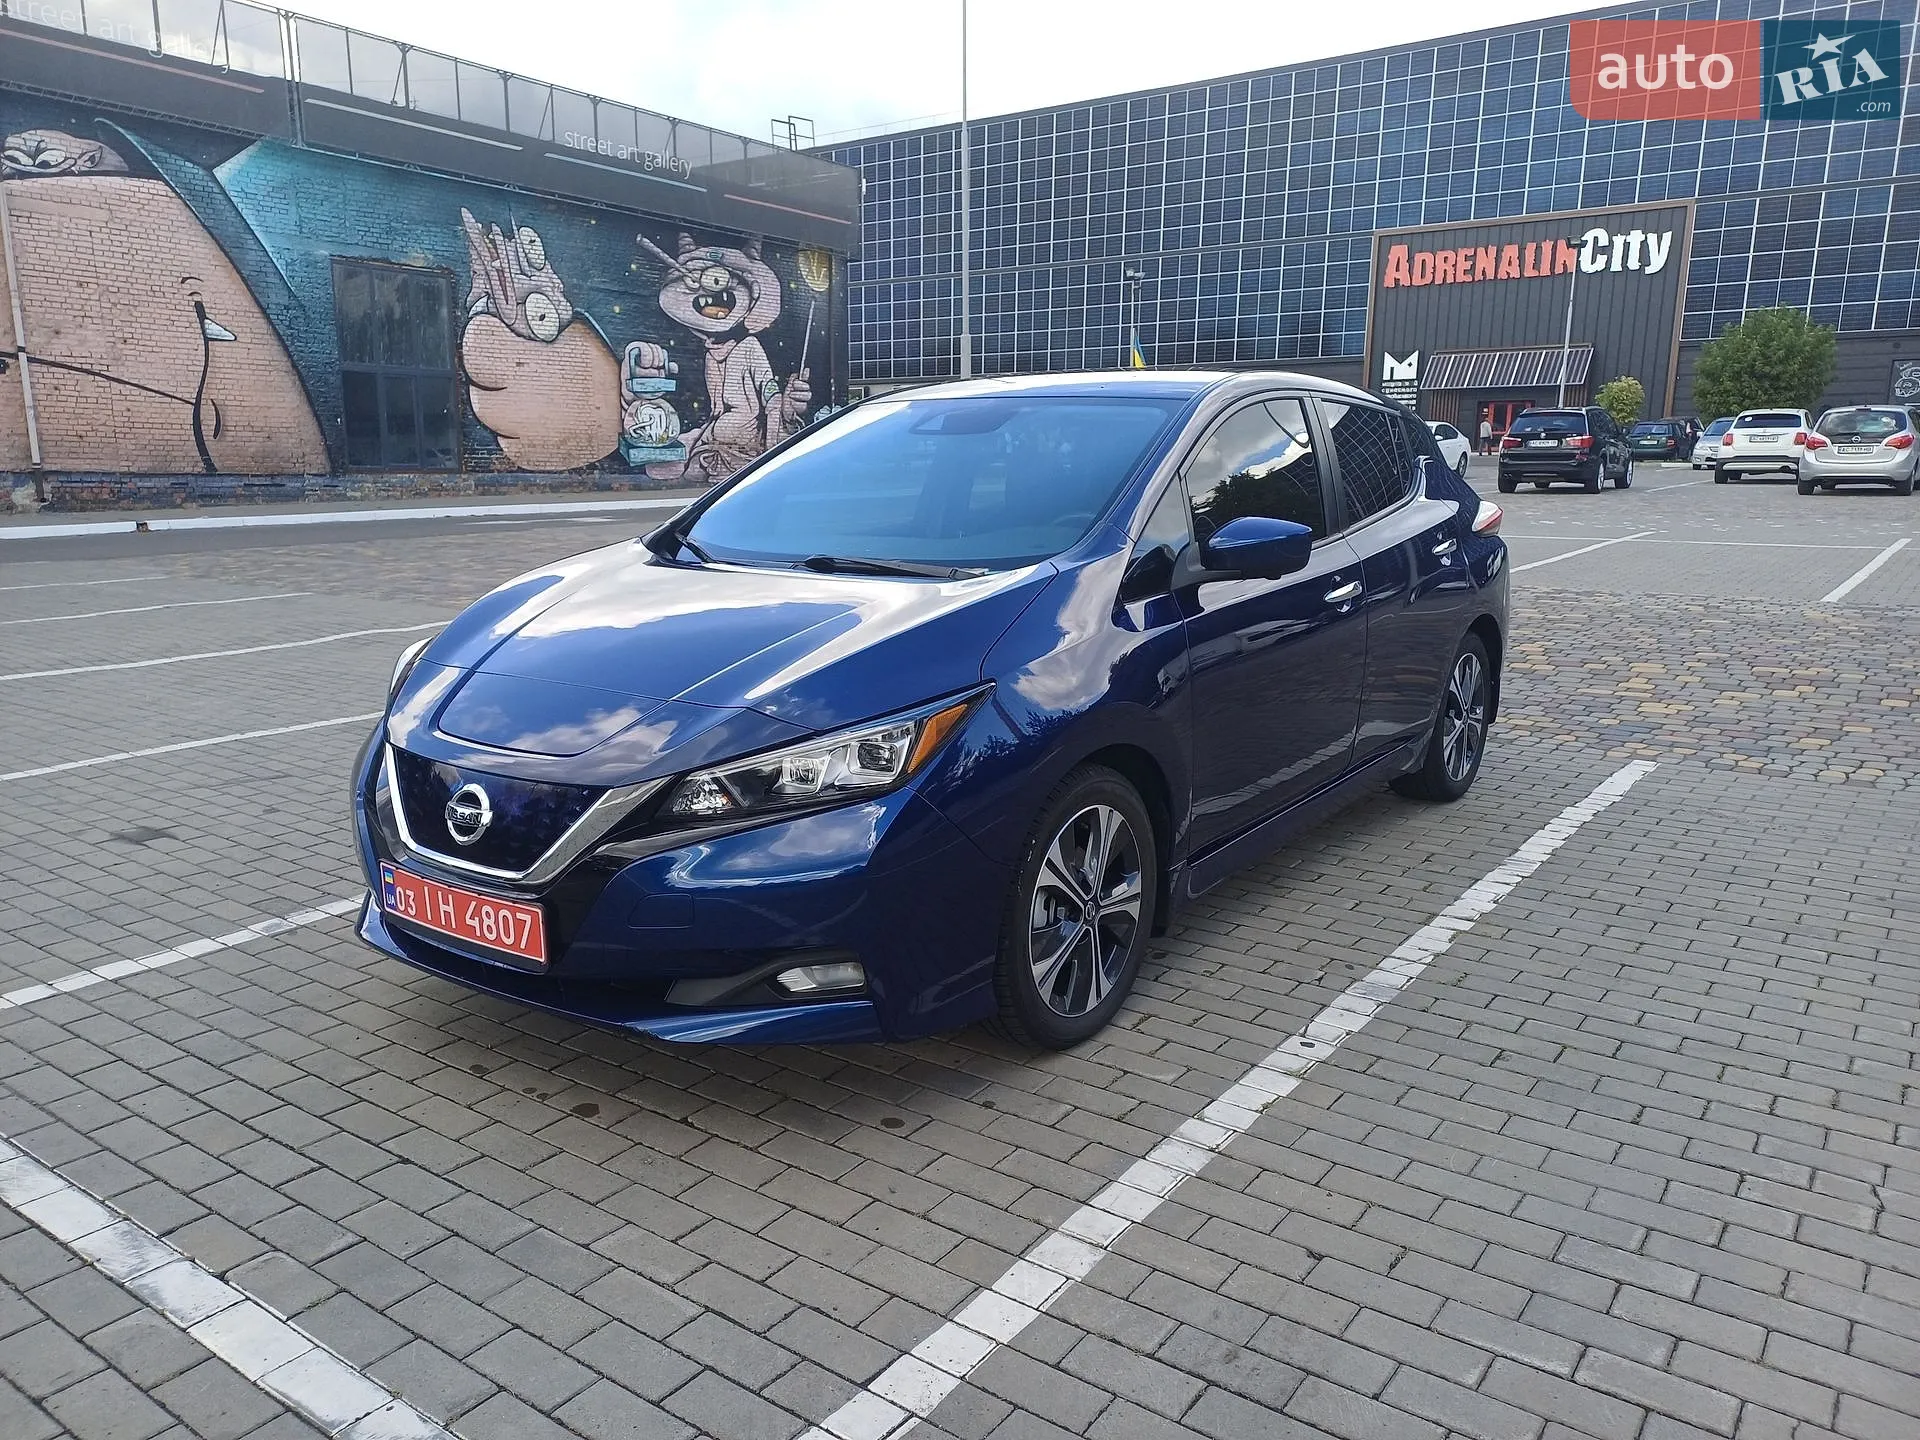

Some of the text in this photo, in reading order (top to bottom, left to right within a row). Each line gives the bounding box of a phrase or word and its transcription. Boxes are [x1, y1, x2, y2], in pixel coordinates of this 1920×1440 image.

[100, 17, 137, 44] art
[148, 29, 232, 76] galle
[564, 131, 692, 179] street art gallery
[447, 804, 484, 826] NISSAN
[386, 893, 396, 907] UA
[395, 886, 417, 917] 03
[465, 900, 532, 950] 4807
